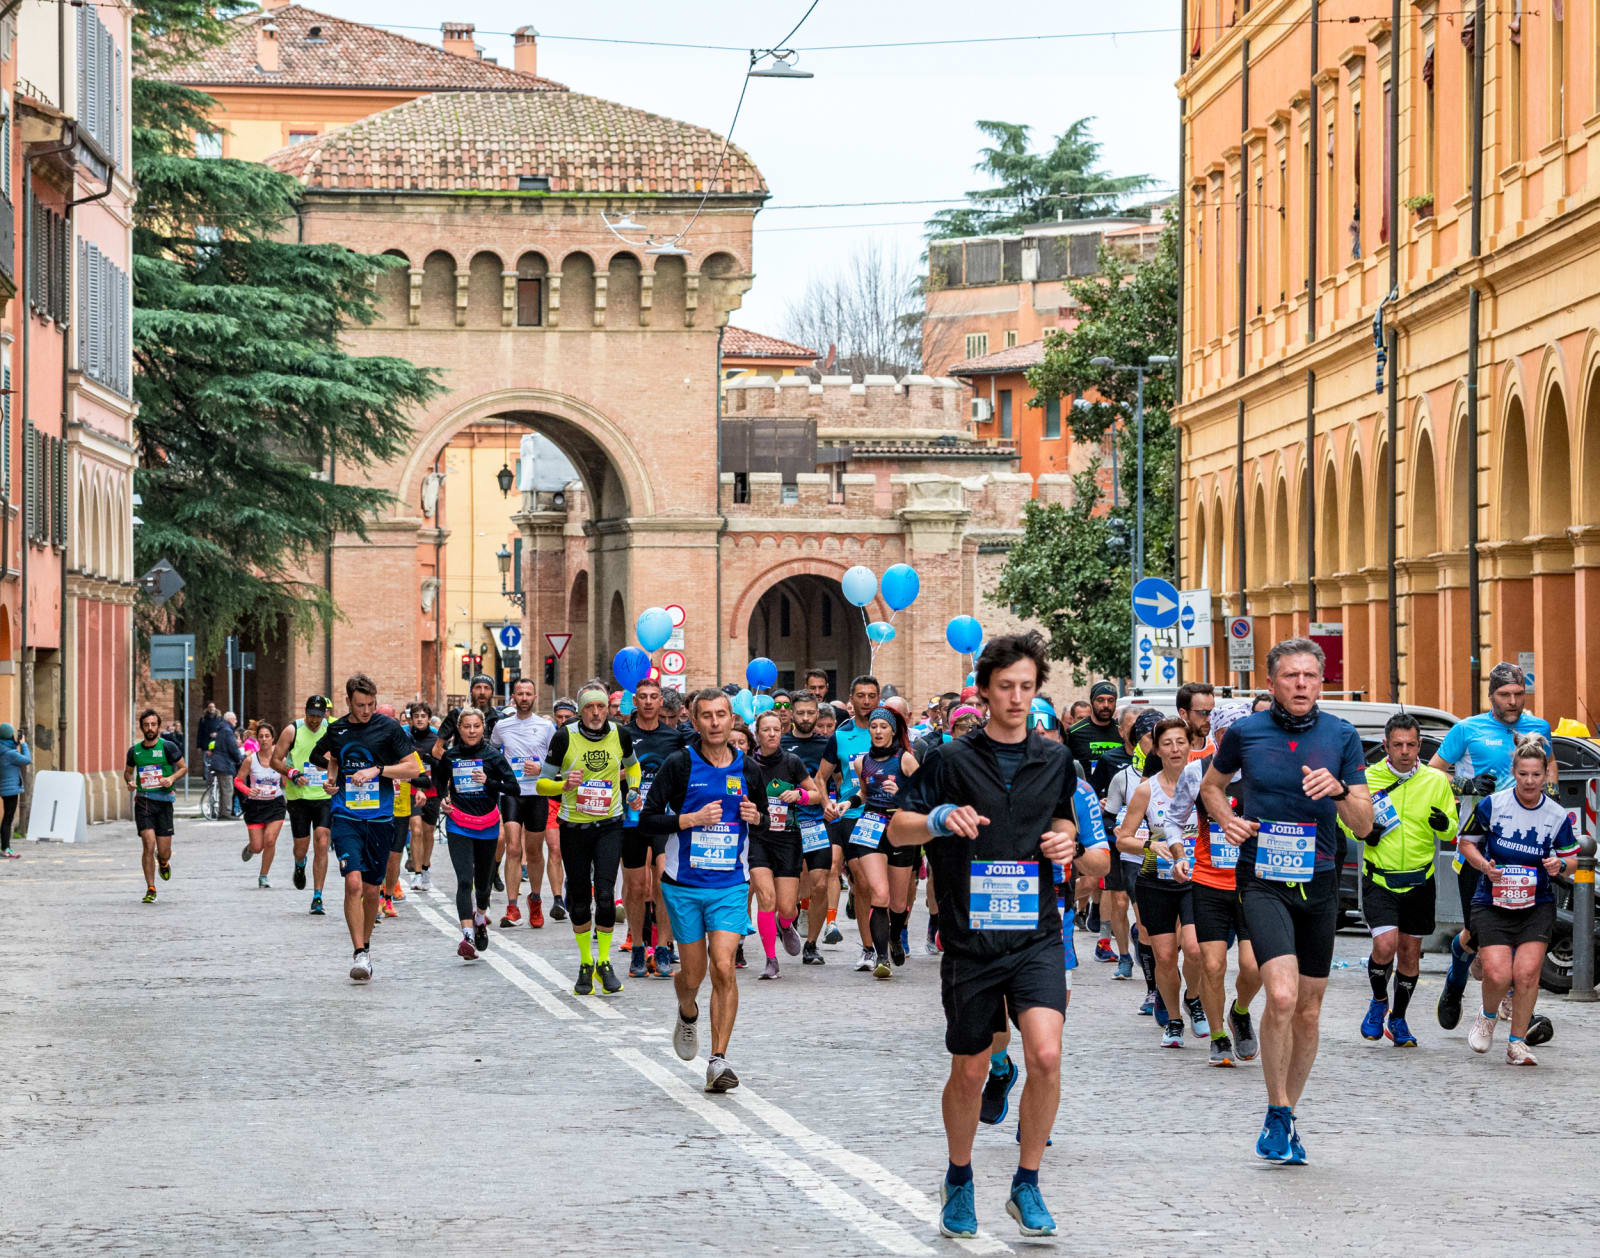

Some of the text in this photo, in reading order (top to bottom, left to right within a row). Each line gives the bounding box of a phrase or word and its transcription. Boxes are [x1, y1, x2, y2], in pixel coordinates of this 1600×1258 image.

[459, 777, 476, 785] 142
[584, 799, 605, 807] 2615
[1084, 792, 1106, 841] ROAD
[1270, 824, 1304, 836] Joma
[704, 849, 725, 860] 441
[1266, 854, 1303, 868] 1090
[985, 864, 1026, 875] Joma
[1500, 890, 1528, 898] 2886
[989, 900, 1020, 912] 885
